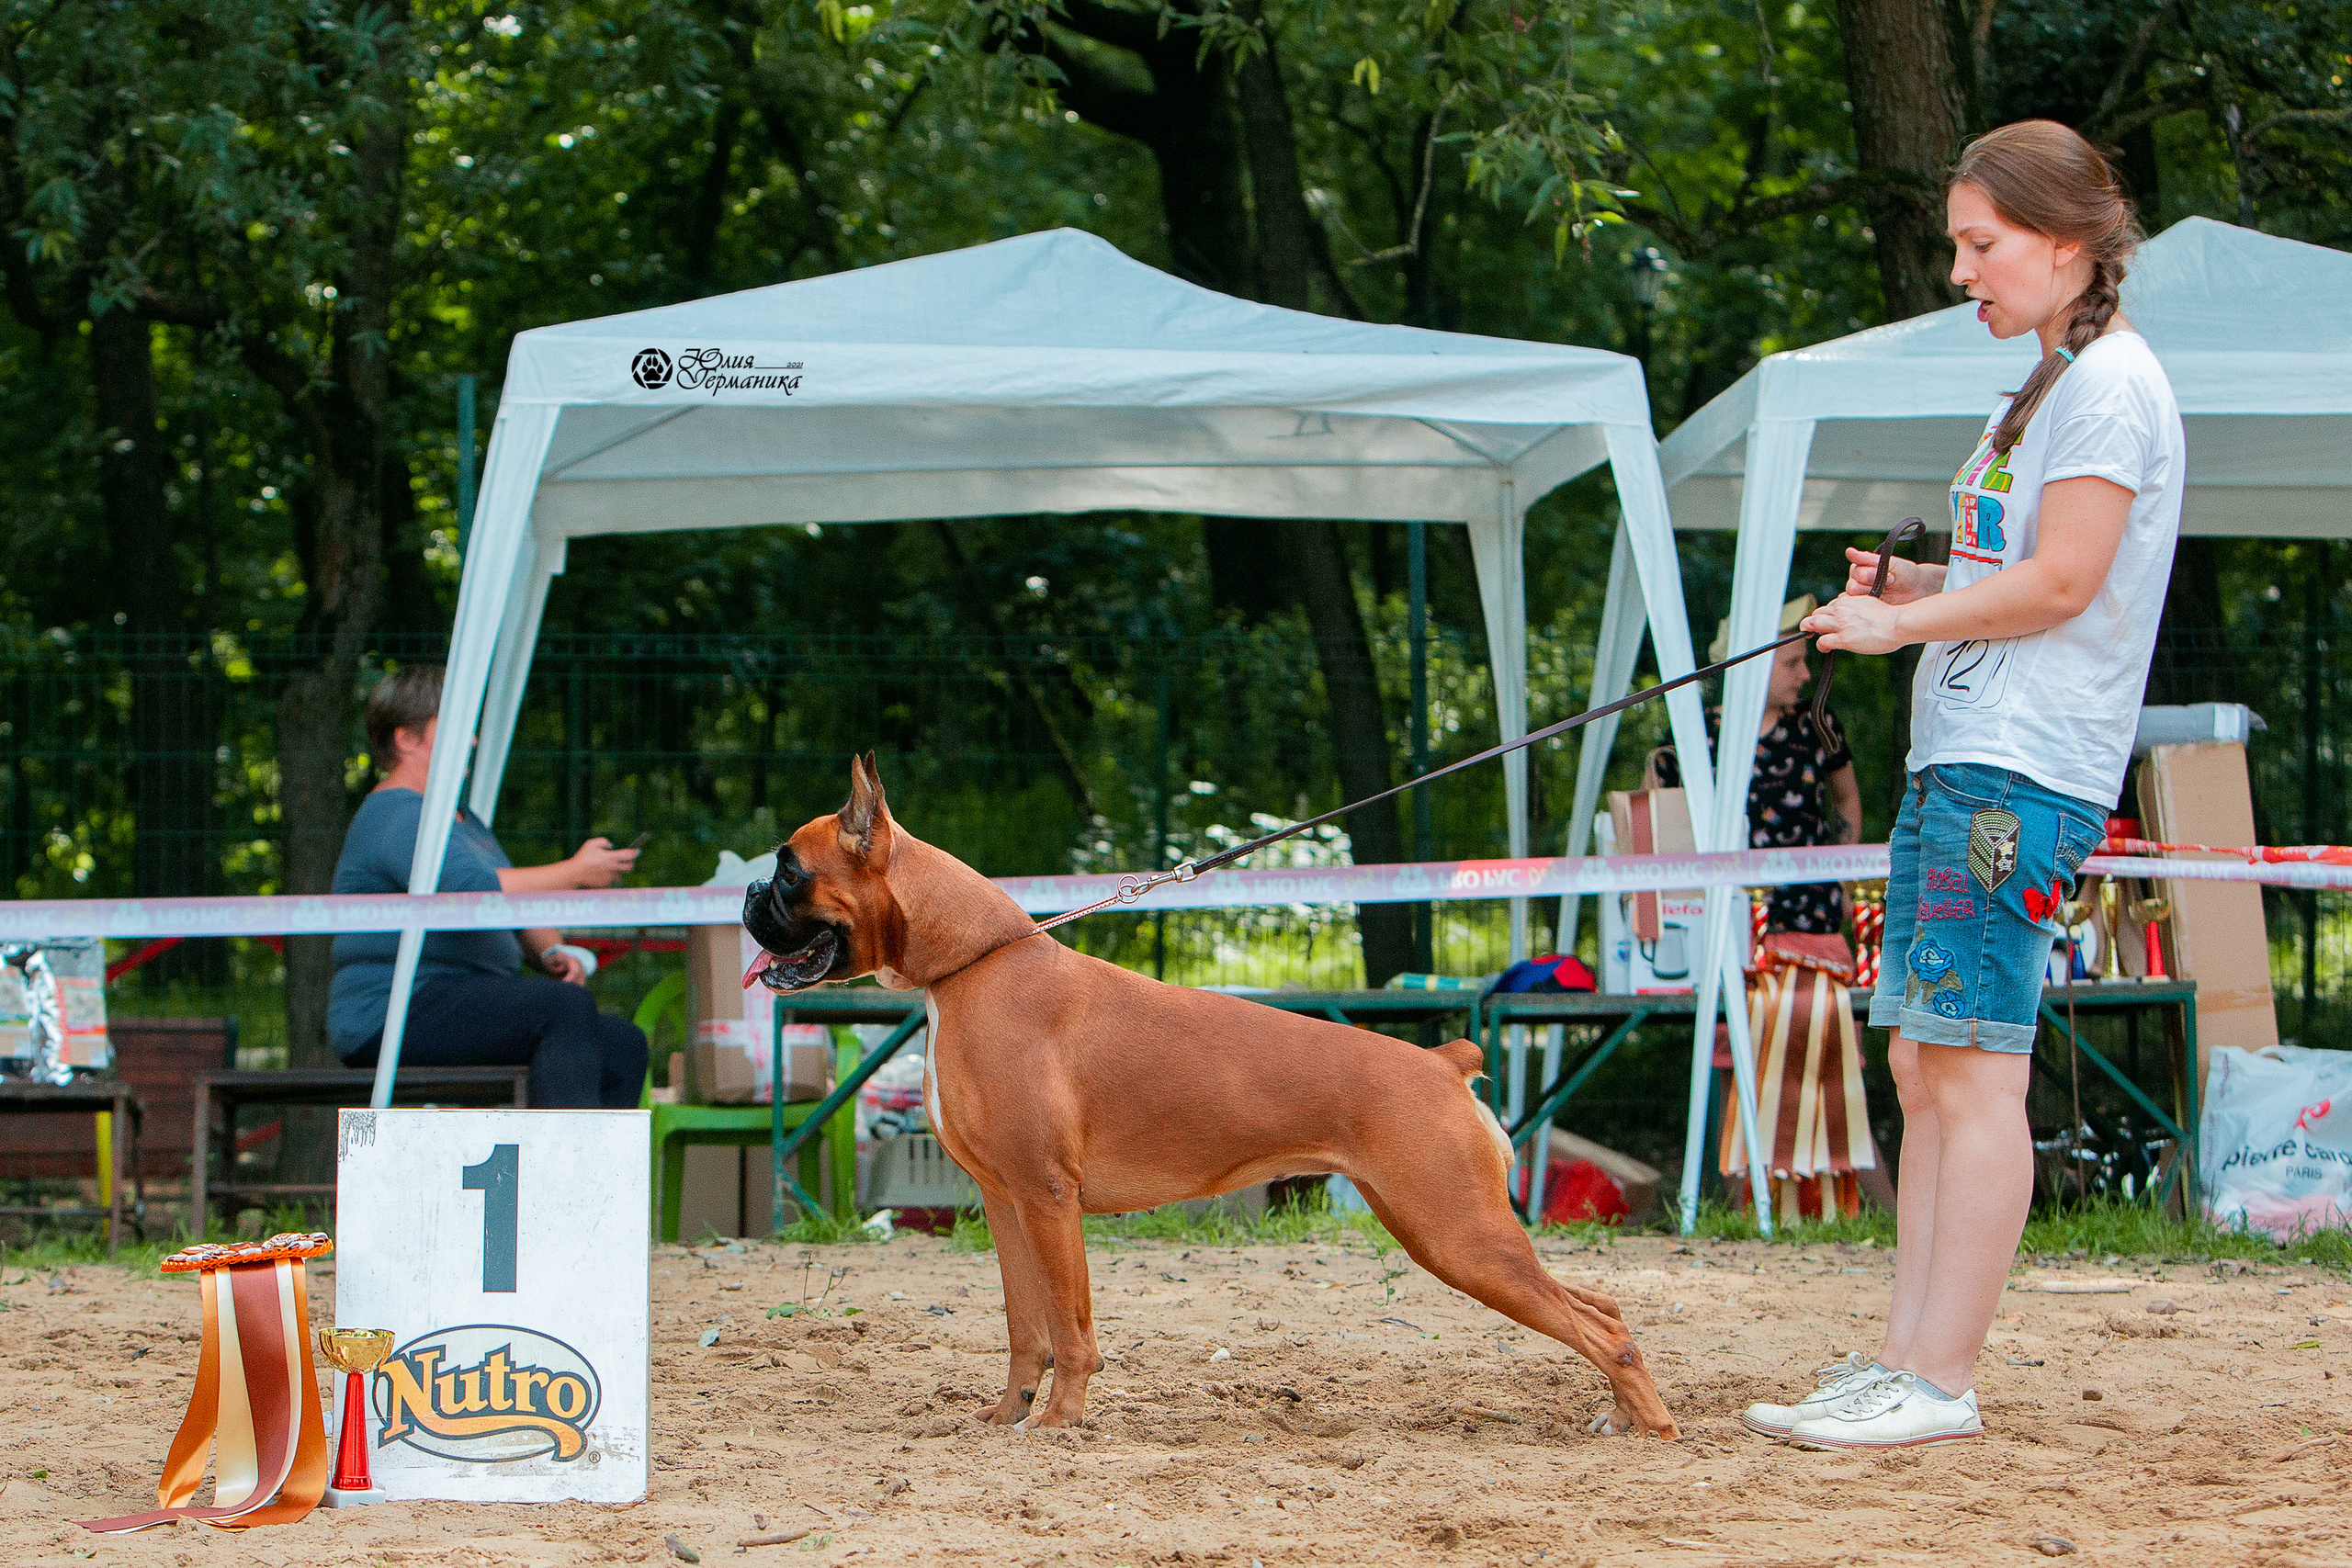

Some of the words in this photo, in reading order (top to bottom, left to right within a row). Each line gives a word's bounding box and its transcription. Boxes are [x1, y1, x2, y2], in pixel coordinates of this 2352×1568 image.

[1939, 638, 1989, 693] 12
[2285, 1166, 2323, 1179] PARIS
[462, 1144, 519, 1293] 1
[378, 1343, 591, 1461] Nutro
